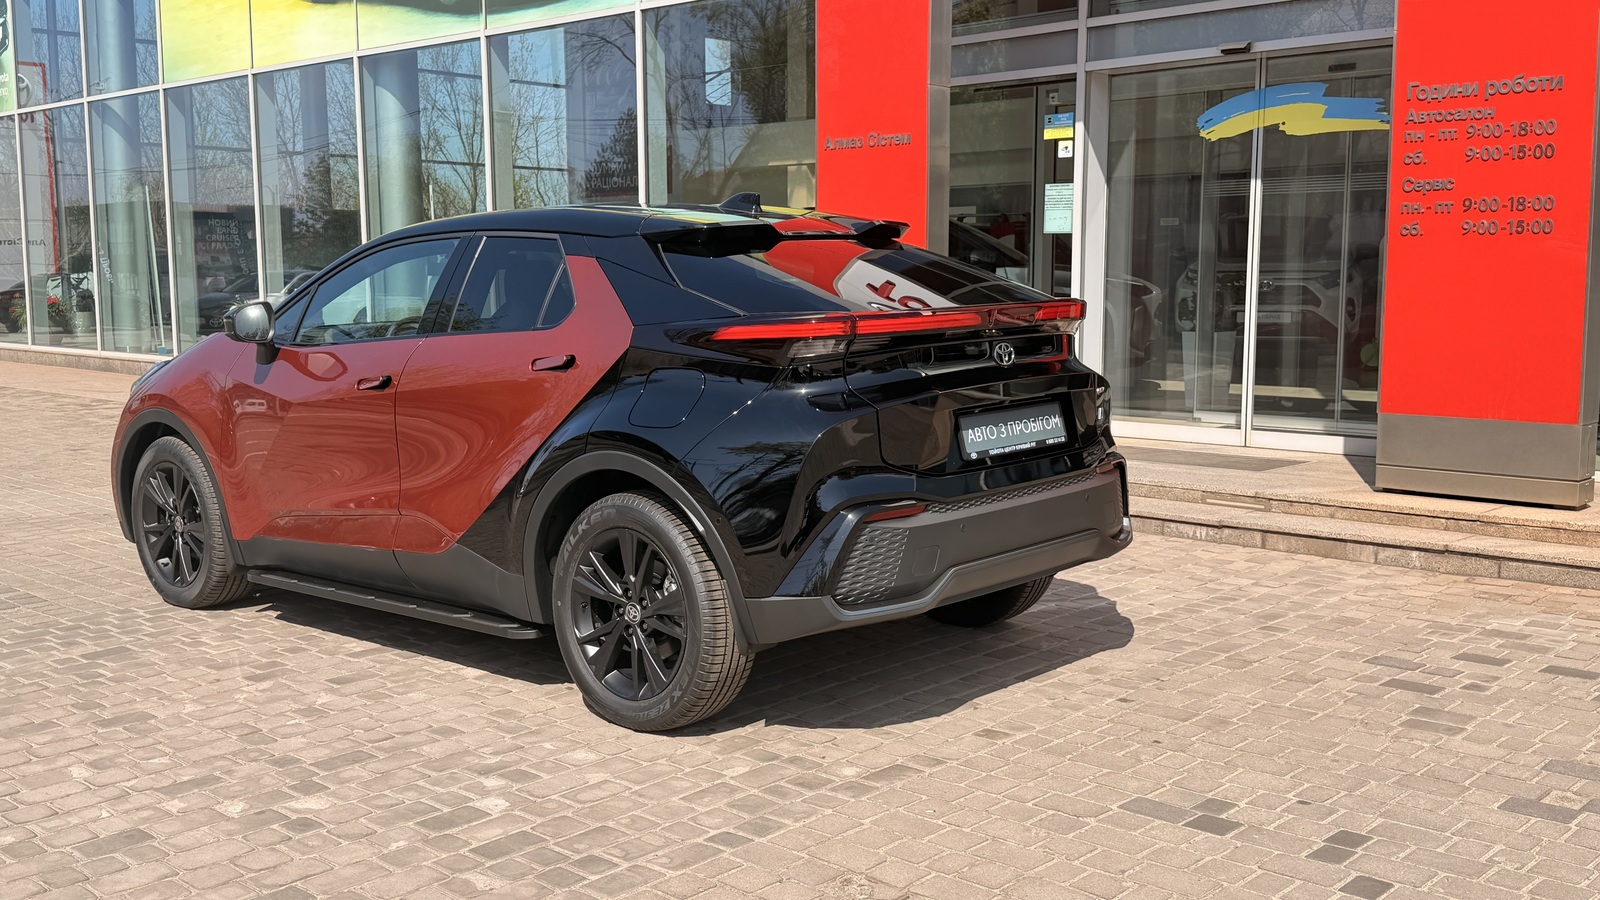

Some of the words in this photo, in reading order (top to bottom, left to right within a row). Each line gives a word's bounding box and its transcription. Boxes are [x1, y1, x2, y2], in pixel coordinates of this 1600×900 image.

[1406, 81, 1479, 103] Години
[1484, 73, 1564, 101] роботи
[1404, 106, 1496, 124] Автосалон
[1465, 119, 1557, 140] 9:00-18:00
[823, 136, 864, 151] Алмаз
[867, 131, 912, 148] Сістем
[1402, 149, 1428, 166] сб.
[1464, 142, 1556, 162] 9:00-15:00
[1402, 177, 1455, 195] Сервіс
[1462, 195, 1555, 213] 9:00-18:00
[1399, 221, 1425, 237] сб.
[1461, 218, 1554, 236] 9:00-15:00
[968, 424, 997, 444] АВТО
[1008, 414, 1061, 436] ПРОБІГОМ
